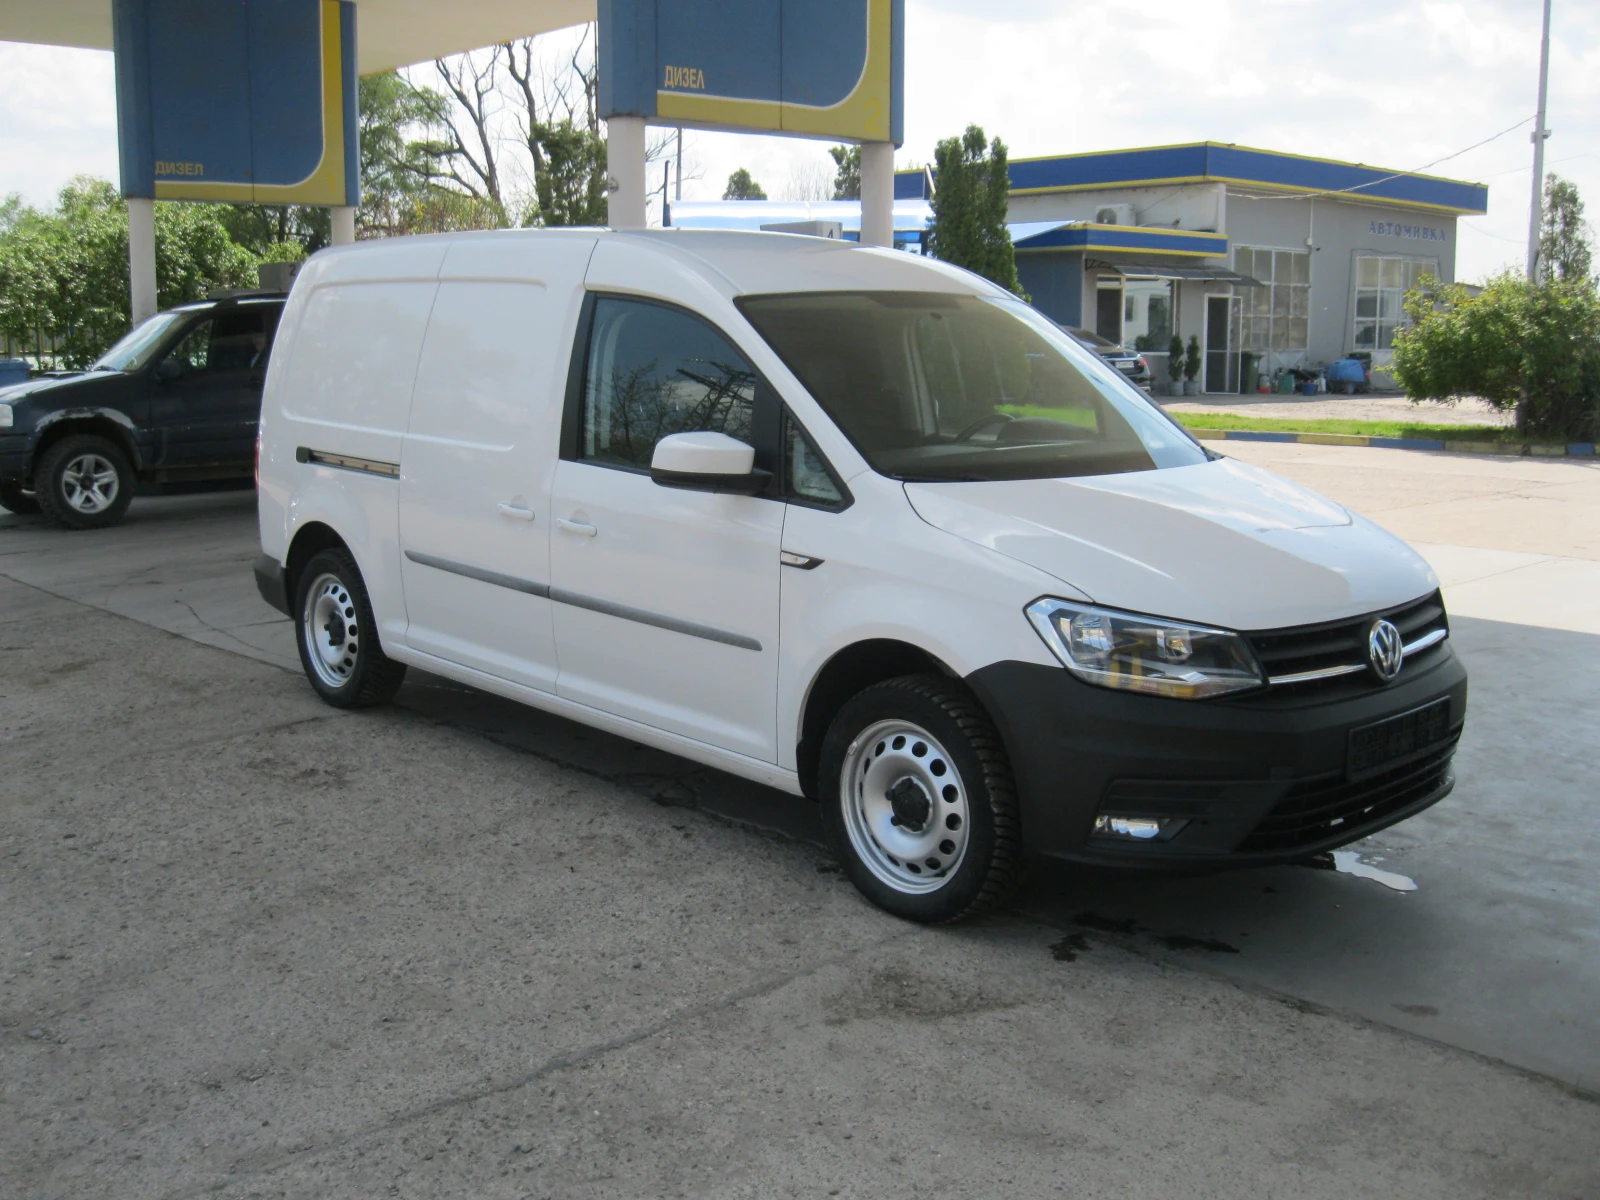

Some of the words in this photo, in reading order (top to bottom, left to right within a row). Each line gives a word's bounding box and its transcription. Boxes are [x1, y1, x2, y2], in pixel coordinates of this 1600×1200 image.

[664, 65, 705, 89] ДИЗЕЛ
[864, 97, 882, 132] 2
[154, 160, 204, 176] ДИЗЕЛ
[1368, 221, 1446, 241] АВТОМИВКА
[289, 263, 297, 277] 2
